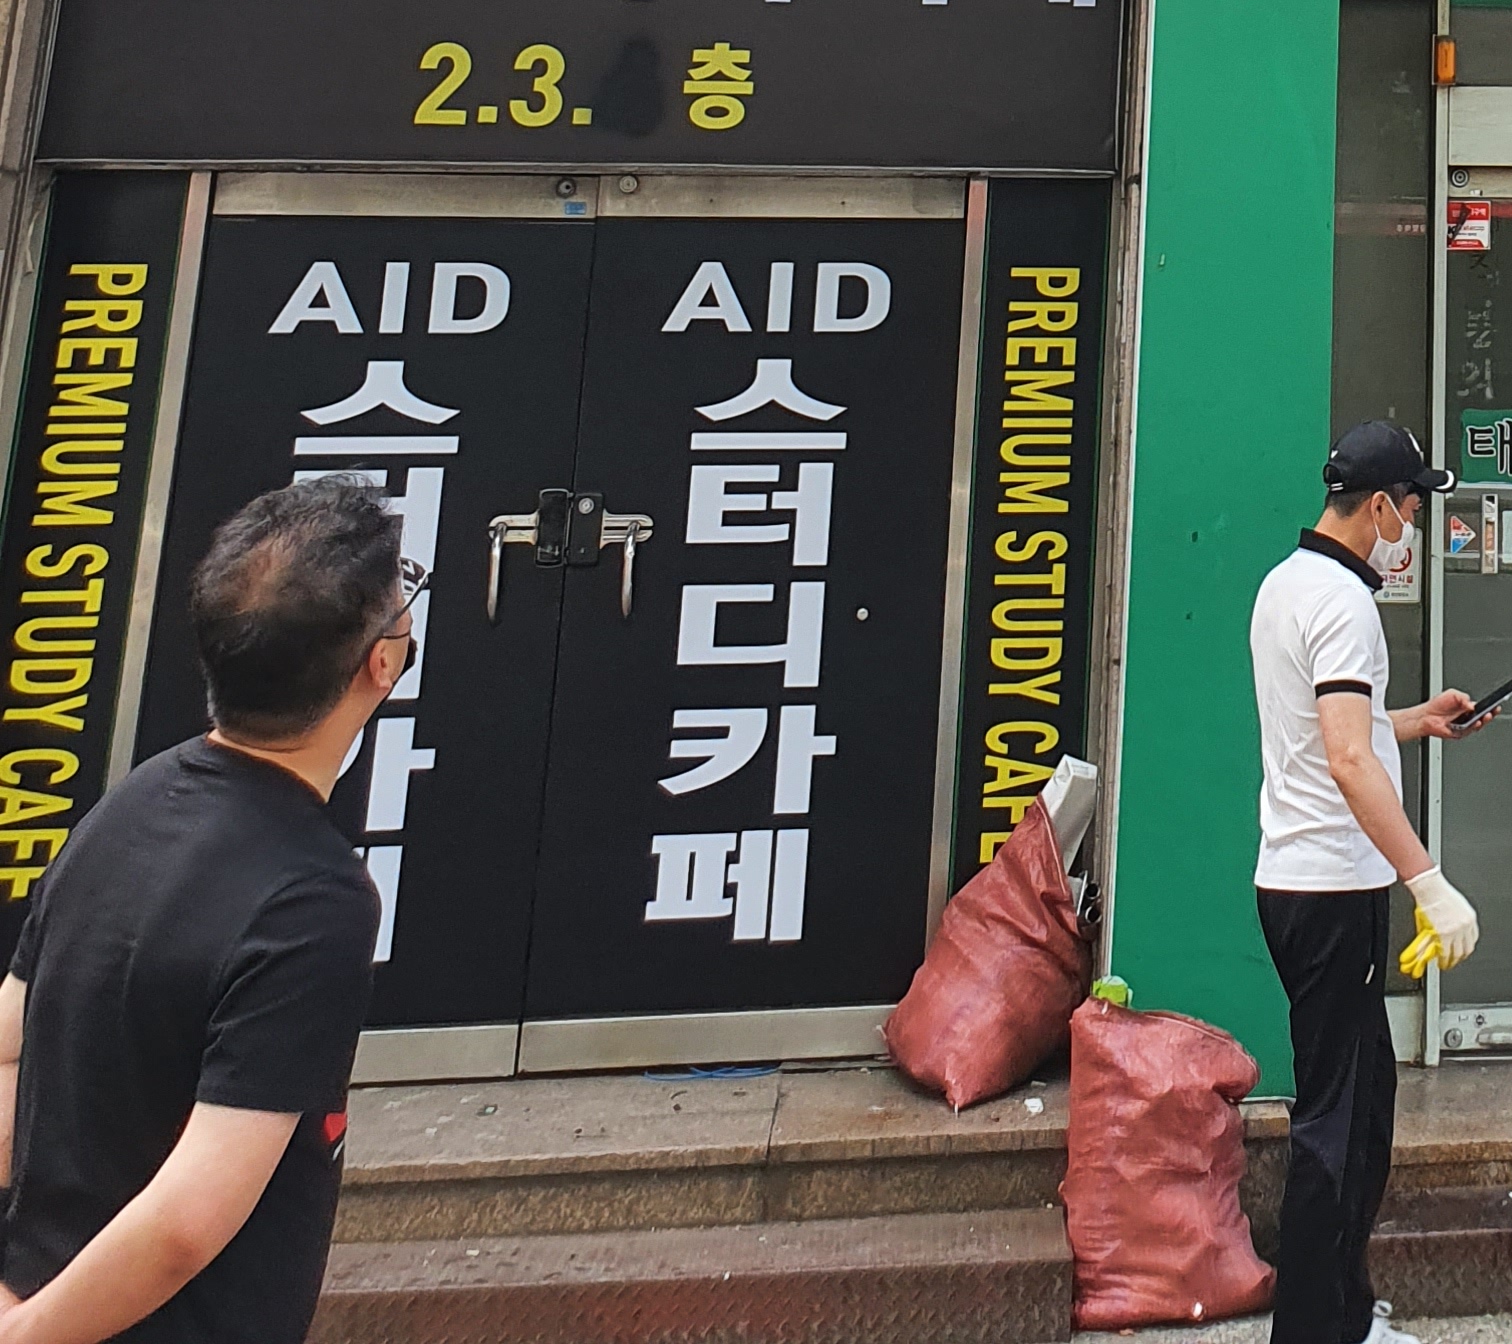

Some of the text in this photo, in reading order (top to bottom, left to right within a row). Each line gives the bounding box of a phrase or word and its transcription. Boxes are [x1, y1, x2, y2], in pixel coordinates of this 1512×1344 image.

[683, 41, 754, 130] 층
[268, 261, 512, 334] AID
[661, 261, 892, 333] AID
[29, 263, 148, 526] PREMIUM
[996, 266, 1081, 515] PREMIUM
[3, 543, 110, 732] STUDY
[988, 529, 1067, 706] STUDY
